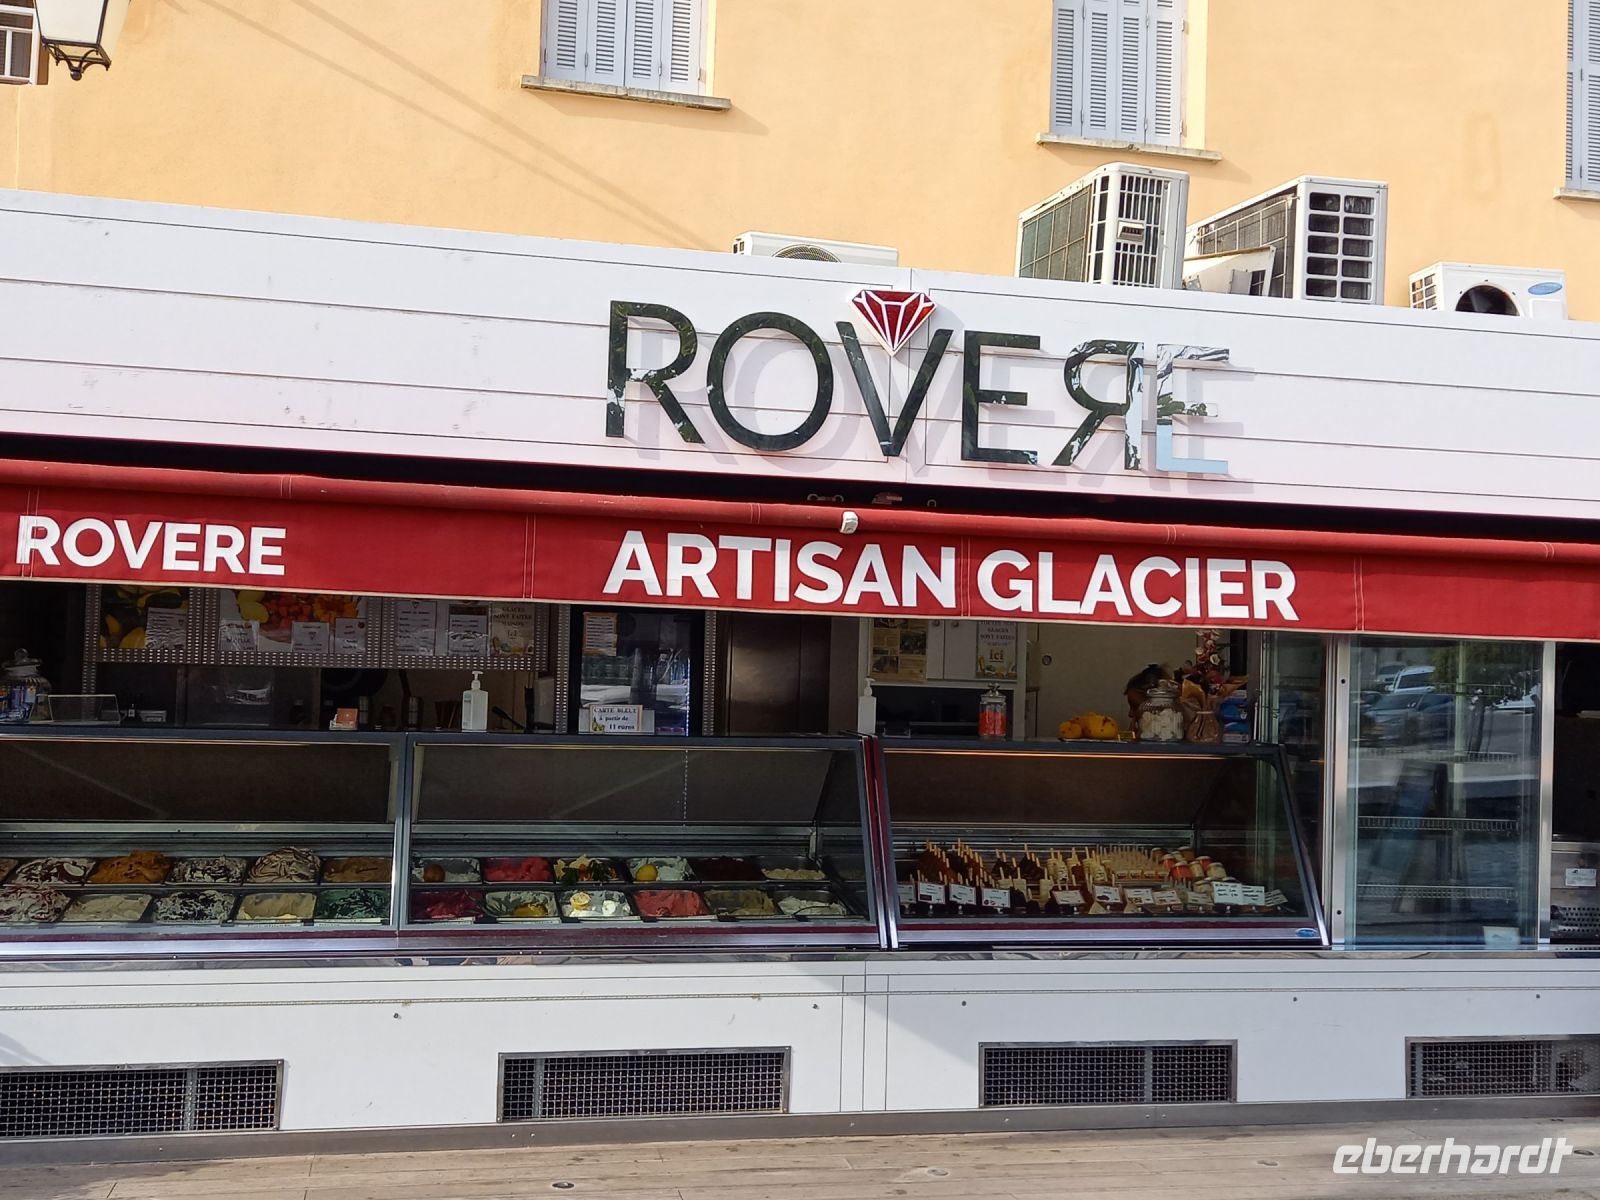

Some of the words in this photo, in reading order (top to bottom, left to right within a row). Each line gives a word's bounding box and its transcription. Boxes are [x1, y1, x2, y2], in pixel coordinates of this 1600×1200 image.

[605, 300, 1229, 474] ROVERE
[16, 515, 286, 576] ROVERE
[602, 530, 957, 609] ARTISAN
[976, 548, 1299, 621] GLACIER
